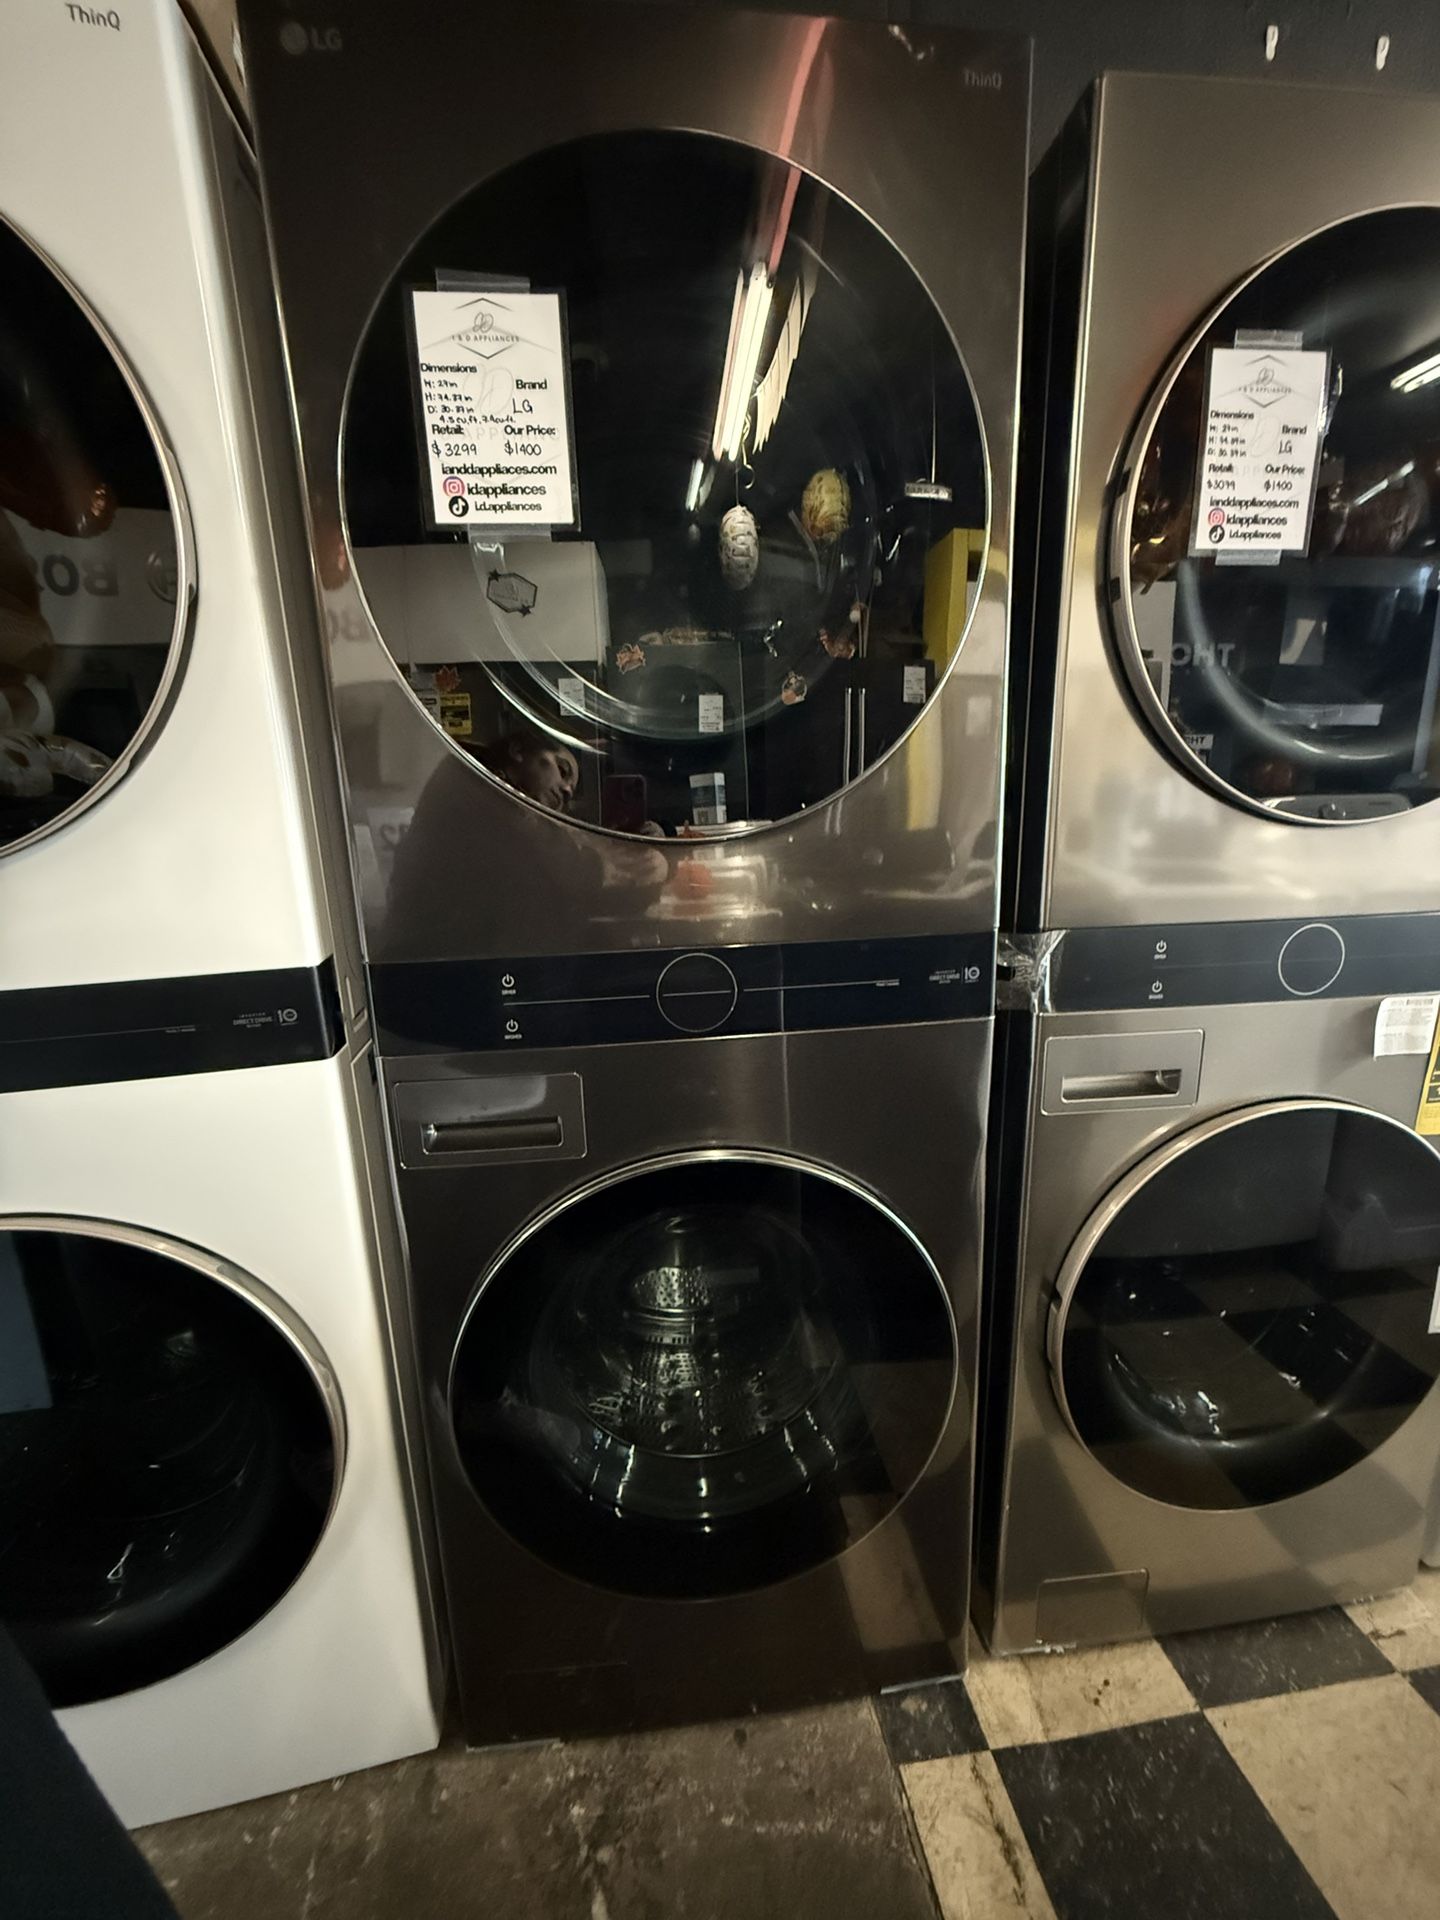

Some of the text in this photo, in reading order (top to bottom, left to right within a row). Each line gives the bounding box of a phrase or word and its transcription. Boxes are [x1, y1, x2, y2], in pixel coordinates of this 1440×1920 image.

[65, 3, 121, 31] ThinQ
[311, 26, 343, 49] LG
[963, 66, 1002, 91] ThinQ
[474, 335, 520, 343] APPLIANCES
[420, 363, 478, 373] Dimensions
[515, 378, 548, 390] Brand
[512, 398, 534, 414] LG
[1210, 410, 1255, 420] Dimensions
[432, 424, 464, 435] Retail:
[504, 425, 525, 435] Our
[526, 425, 556, 435] Price:
[1282, 424, 1308, 435] Brand
[504, 440, 542, 456] $1400
[1279, 439, 1293, 455] LG
[1265, 464, 1281, 474] Our
[467, 483, 547, 498] idappliances
